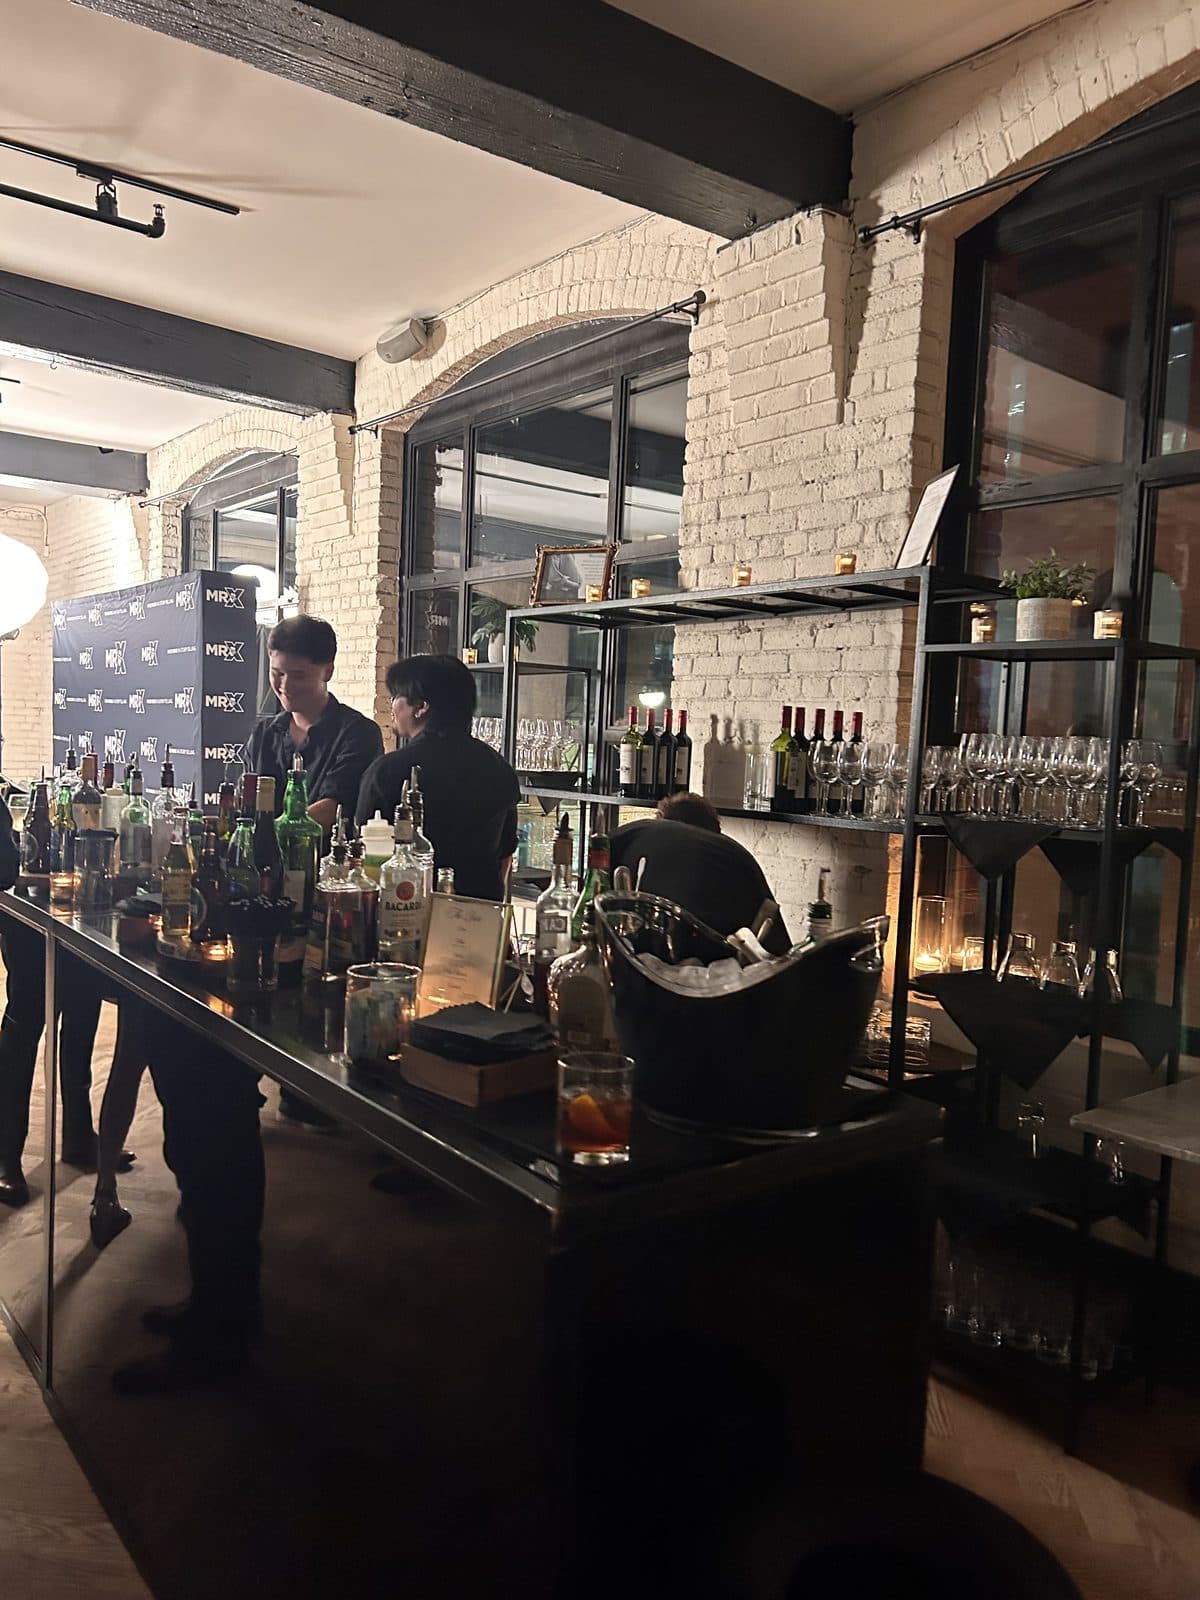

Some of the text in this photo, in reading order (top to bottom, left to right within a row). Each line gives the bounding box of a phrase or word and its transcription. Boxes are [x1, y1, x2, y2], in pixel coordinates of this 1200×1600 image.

[206, 586, 245, 609] MRX
[205, 641, 245, 663] MRX
[205, 692, 245, 713] MRX
[204, 743, 244, 764] MRX
